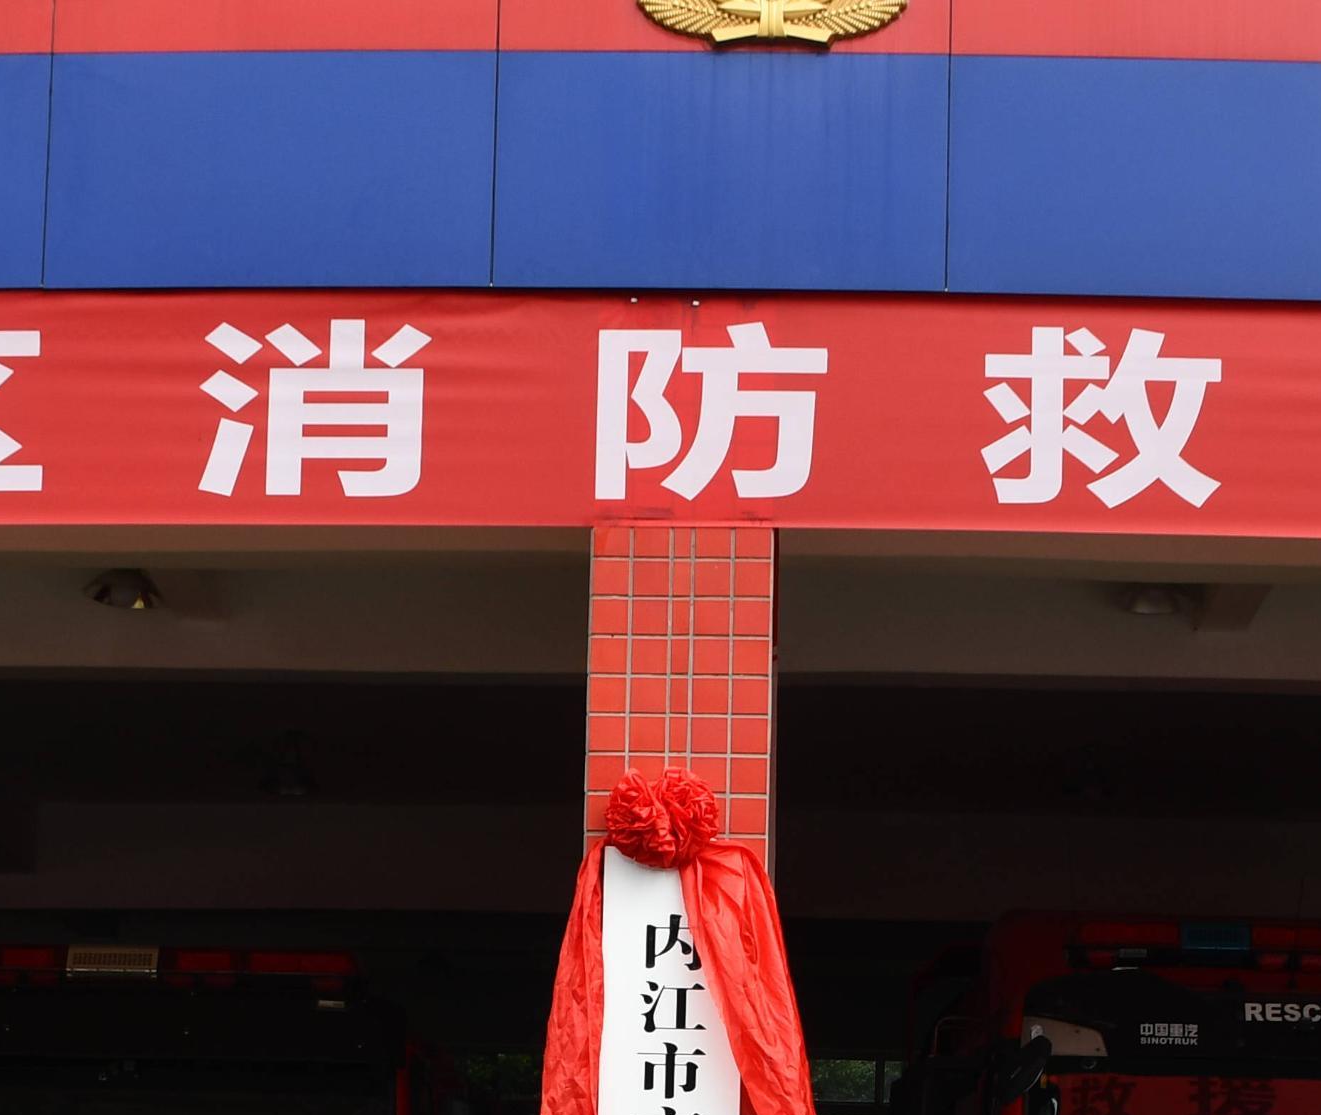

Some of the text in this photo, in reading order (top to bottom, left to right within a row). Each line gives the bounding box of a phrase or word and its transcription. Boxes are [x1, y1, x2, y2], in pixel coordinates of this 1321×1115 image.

[1140, 1023, 1198, 1037] 中国重汽
[1140, 1036, 1198, 1046] SINOTRUK
